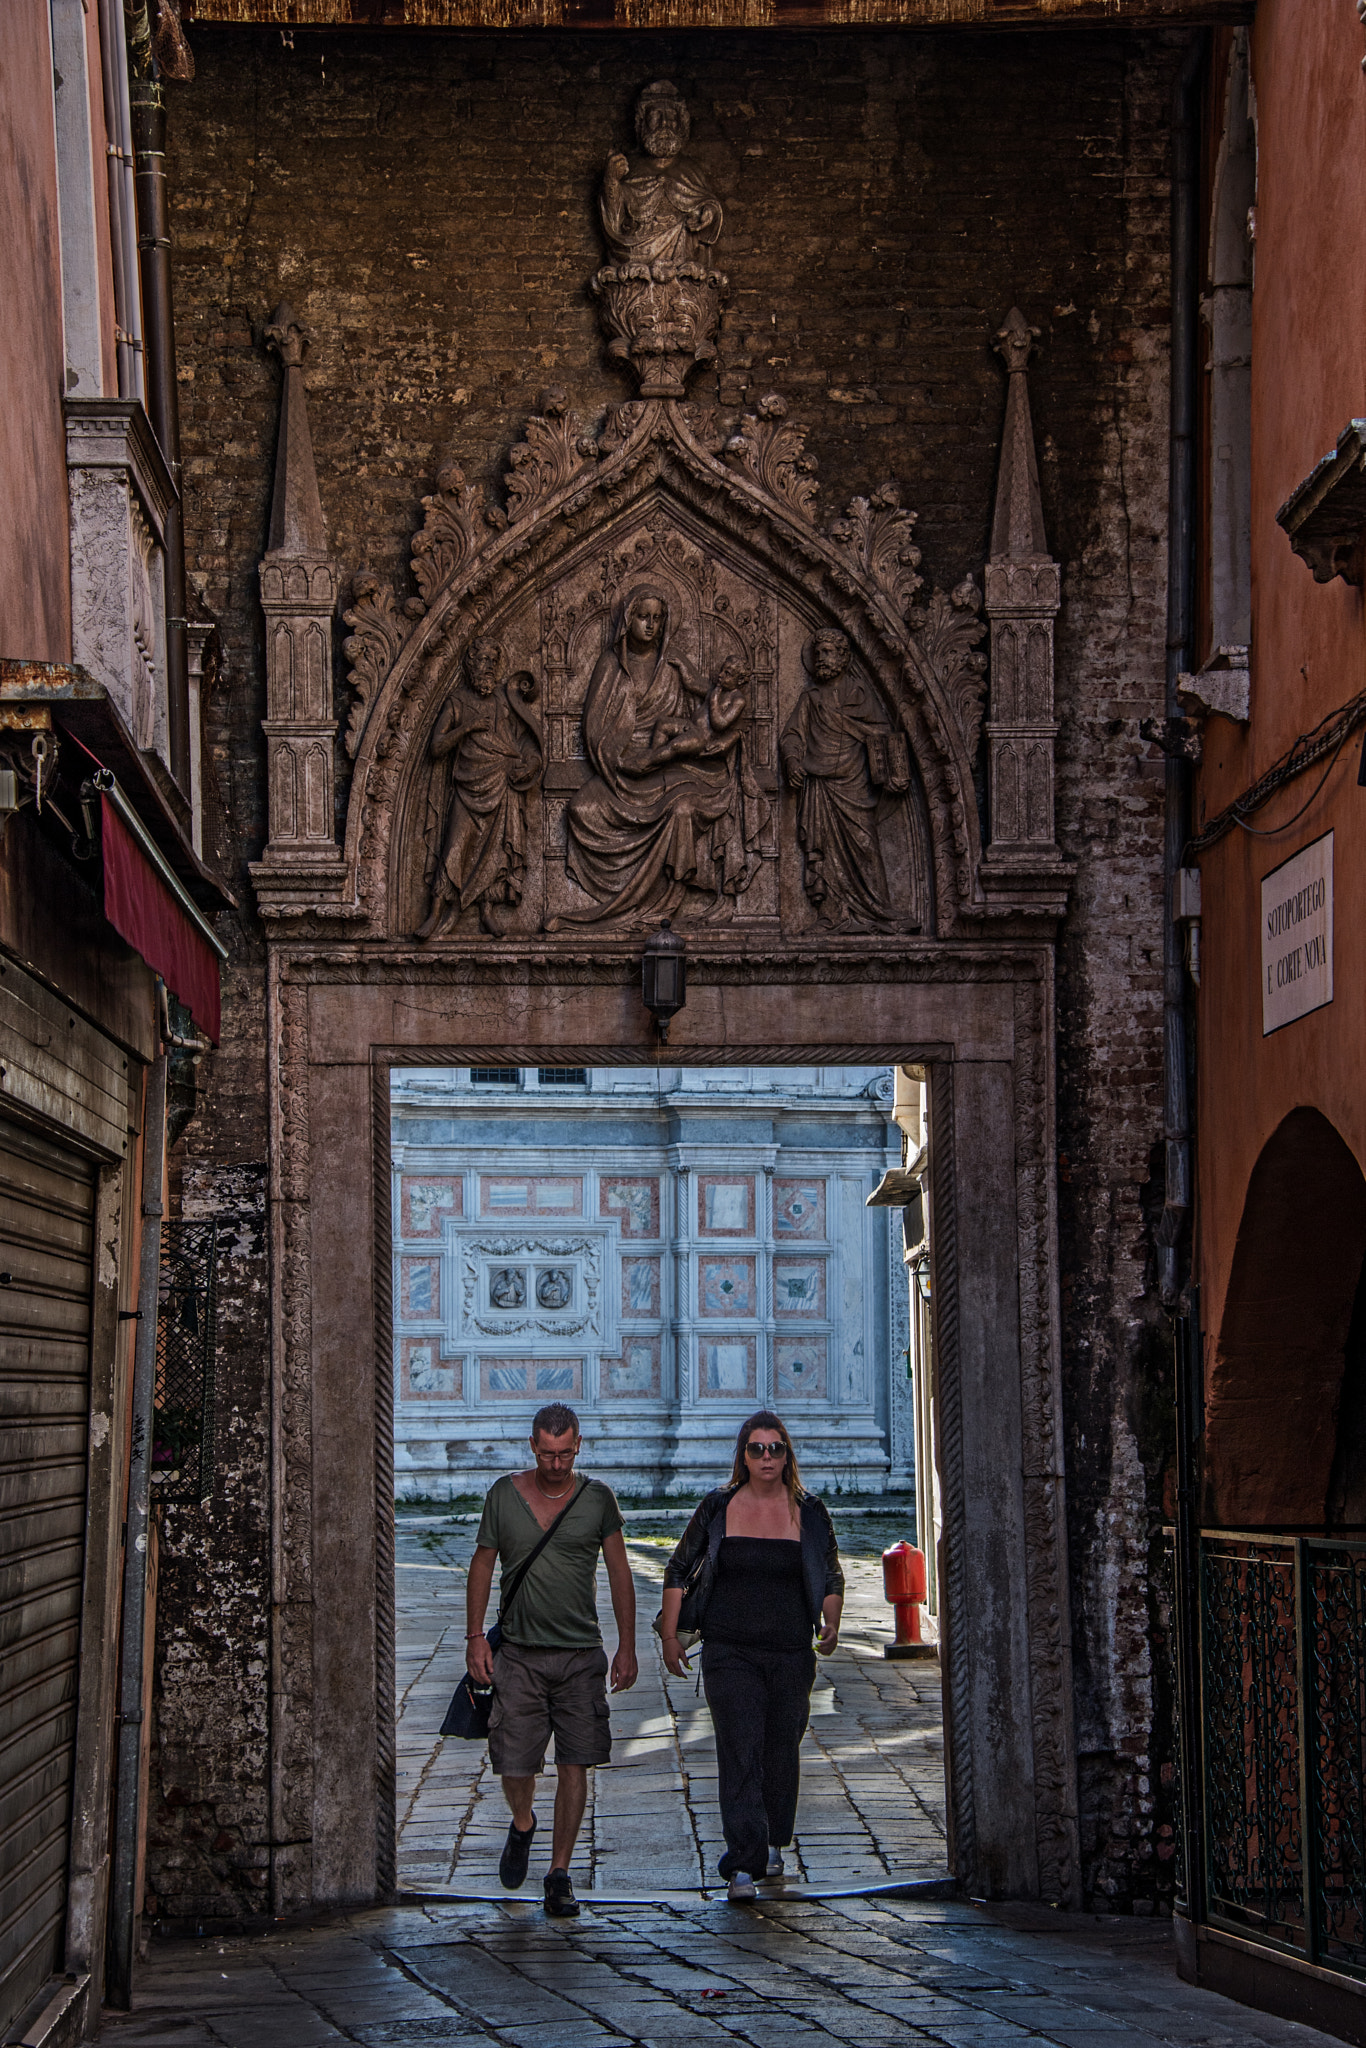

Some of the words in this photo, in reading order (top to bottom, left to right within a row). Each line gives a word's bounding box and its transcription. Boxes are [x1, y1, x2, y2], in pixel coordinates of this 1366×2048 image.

[1267, 877, 1325, 941] SOTOPORTEGO
[1267, 964, 1273, 995] E
[1277, 946, 1302, 988] CORTE
[1304, 934, 1326, 974] NOVA
